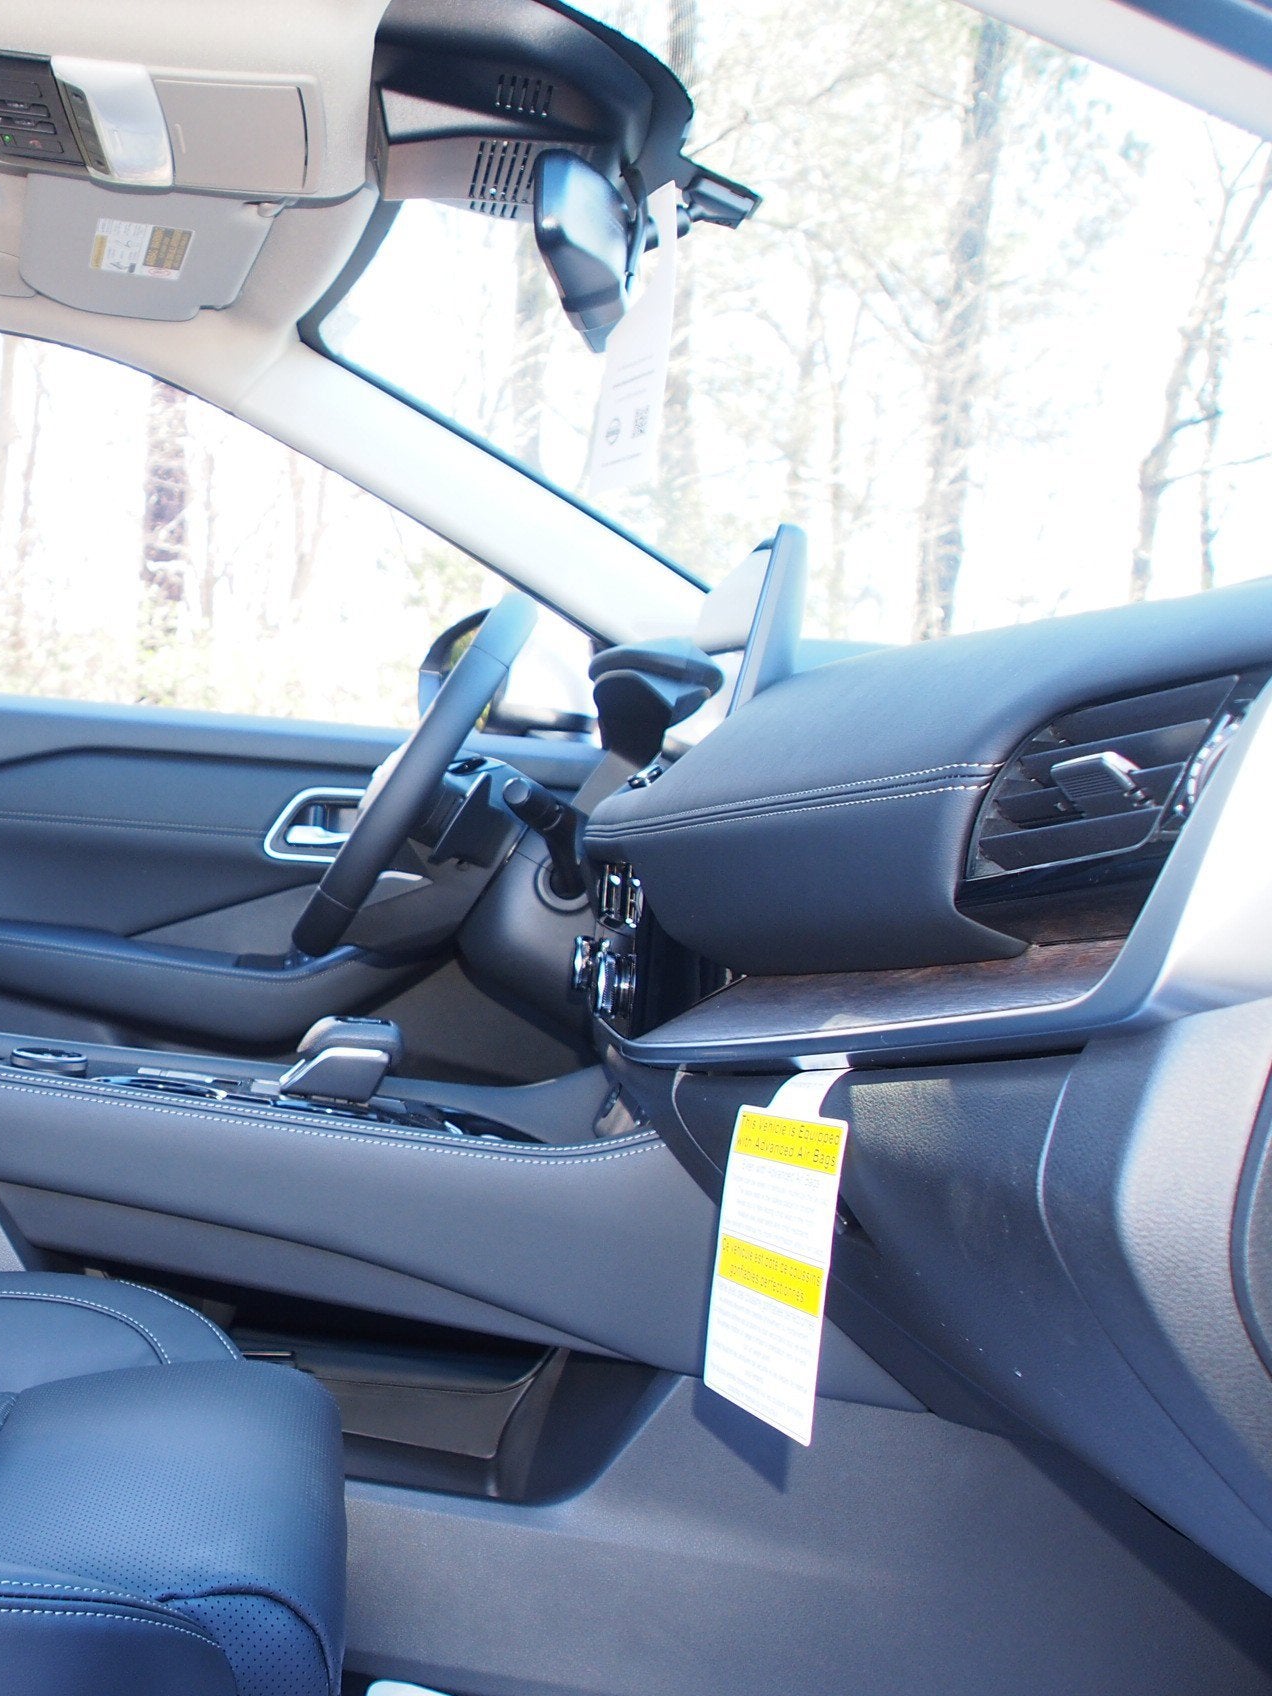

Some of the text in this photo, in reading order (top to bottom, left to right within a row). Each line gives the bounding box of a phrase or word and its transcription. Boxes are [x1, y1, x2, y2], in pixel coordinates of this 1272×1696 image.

[741, 1114, 756, 1130] This
[789, 1125, 796, 1137] is
[799, 1124, 840, 1146] Equipped
[736, 1136, 836, 1169] with Advanced Air Bags
